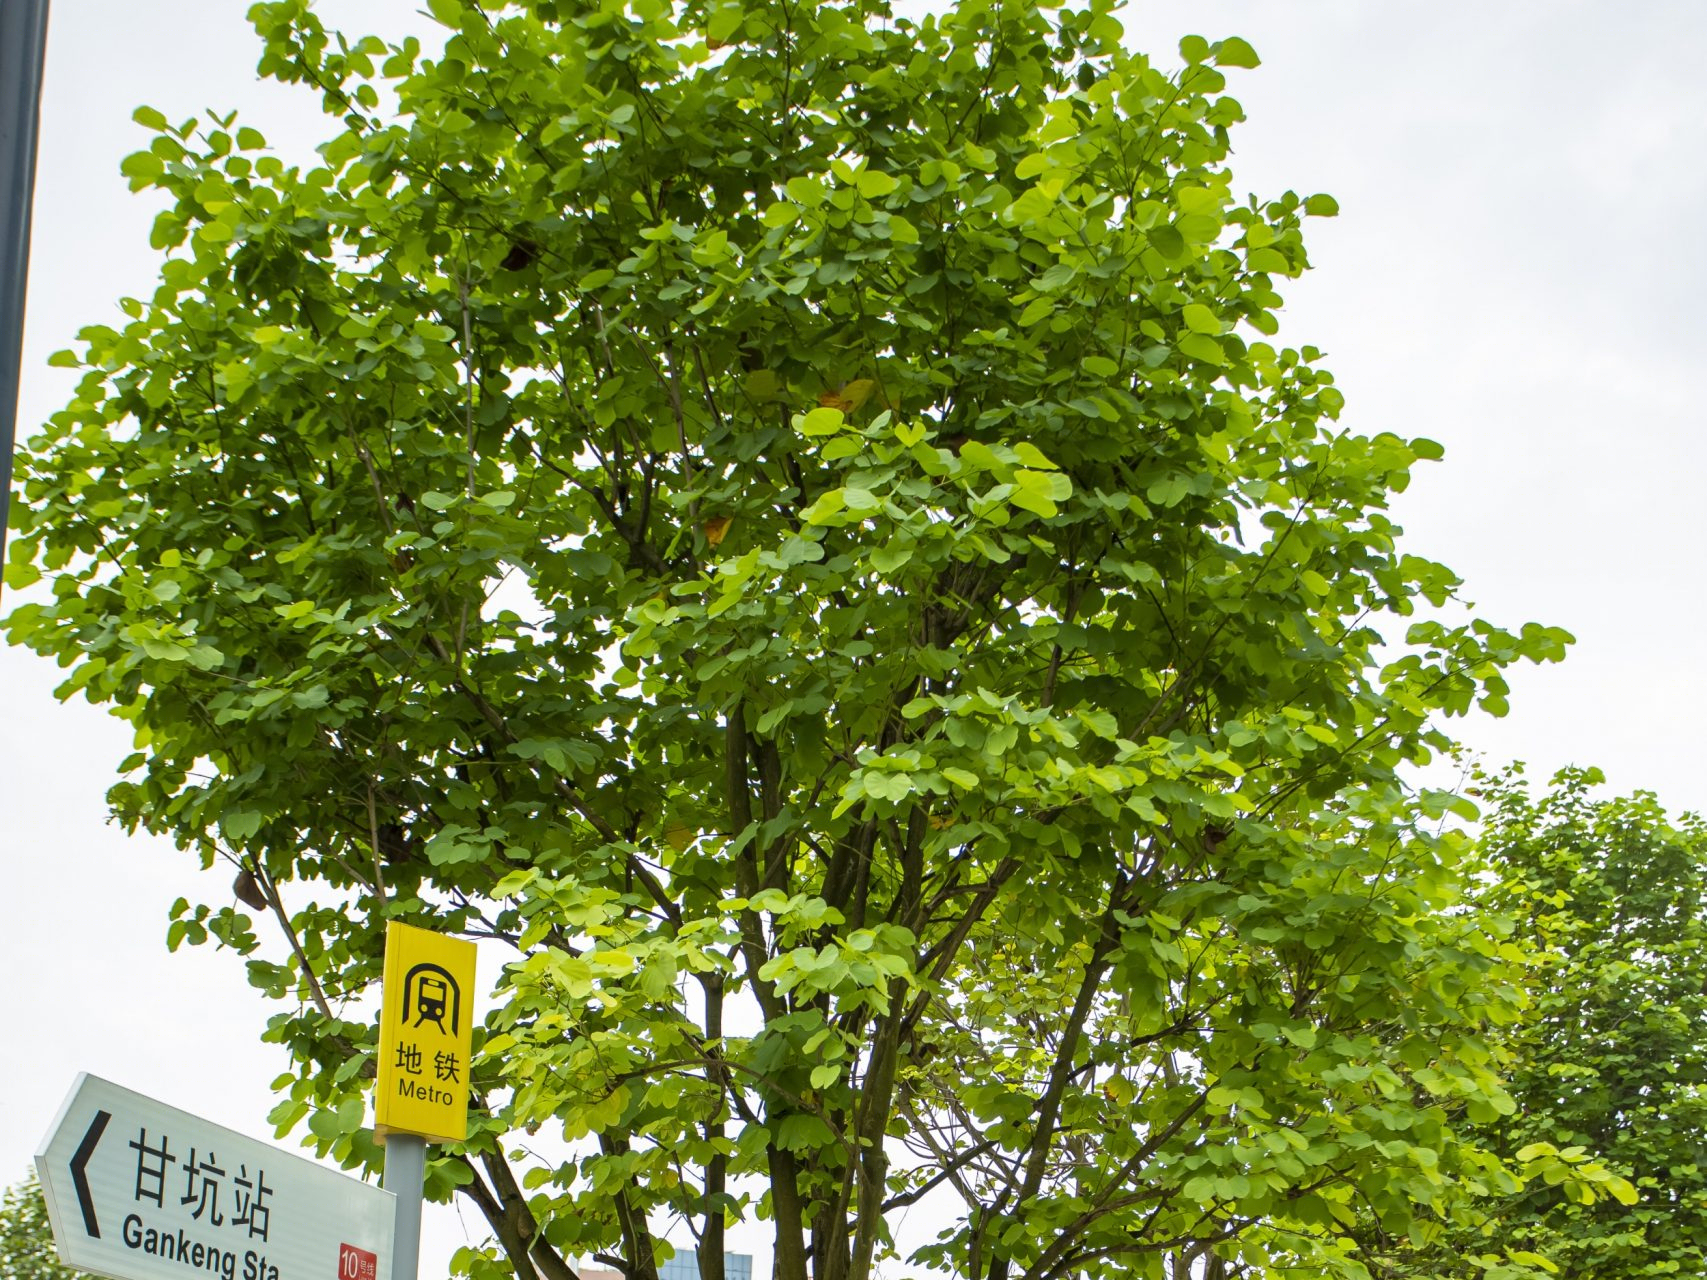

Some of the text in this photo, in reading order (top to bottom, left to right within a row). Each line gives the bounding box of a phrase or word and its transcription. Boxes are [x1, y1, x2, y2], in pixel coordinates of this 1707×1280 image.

[395, 1041, 460, 1084] 地铁
[399, 1078, 453, 1106] Metro
[129, 1127, 273, 1242] 甘坑站
